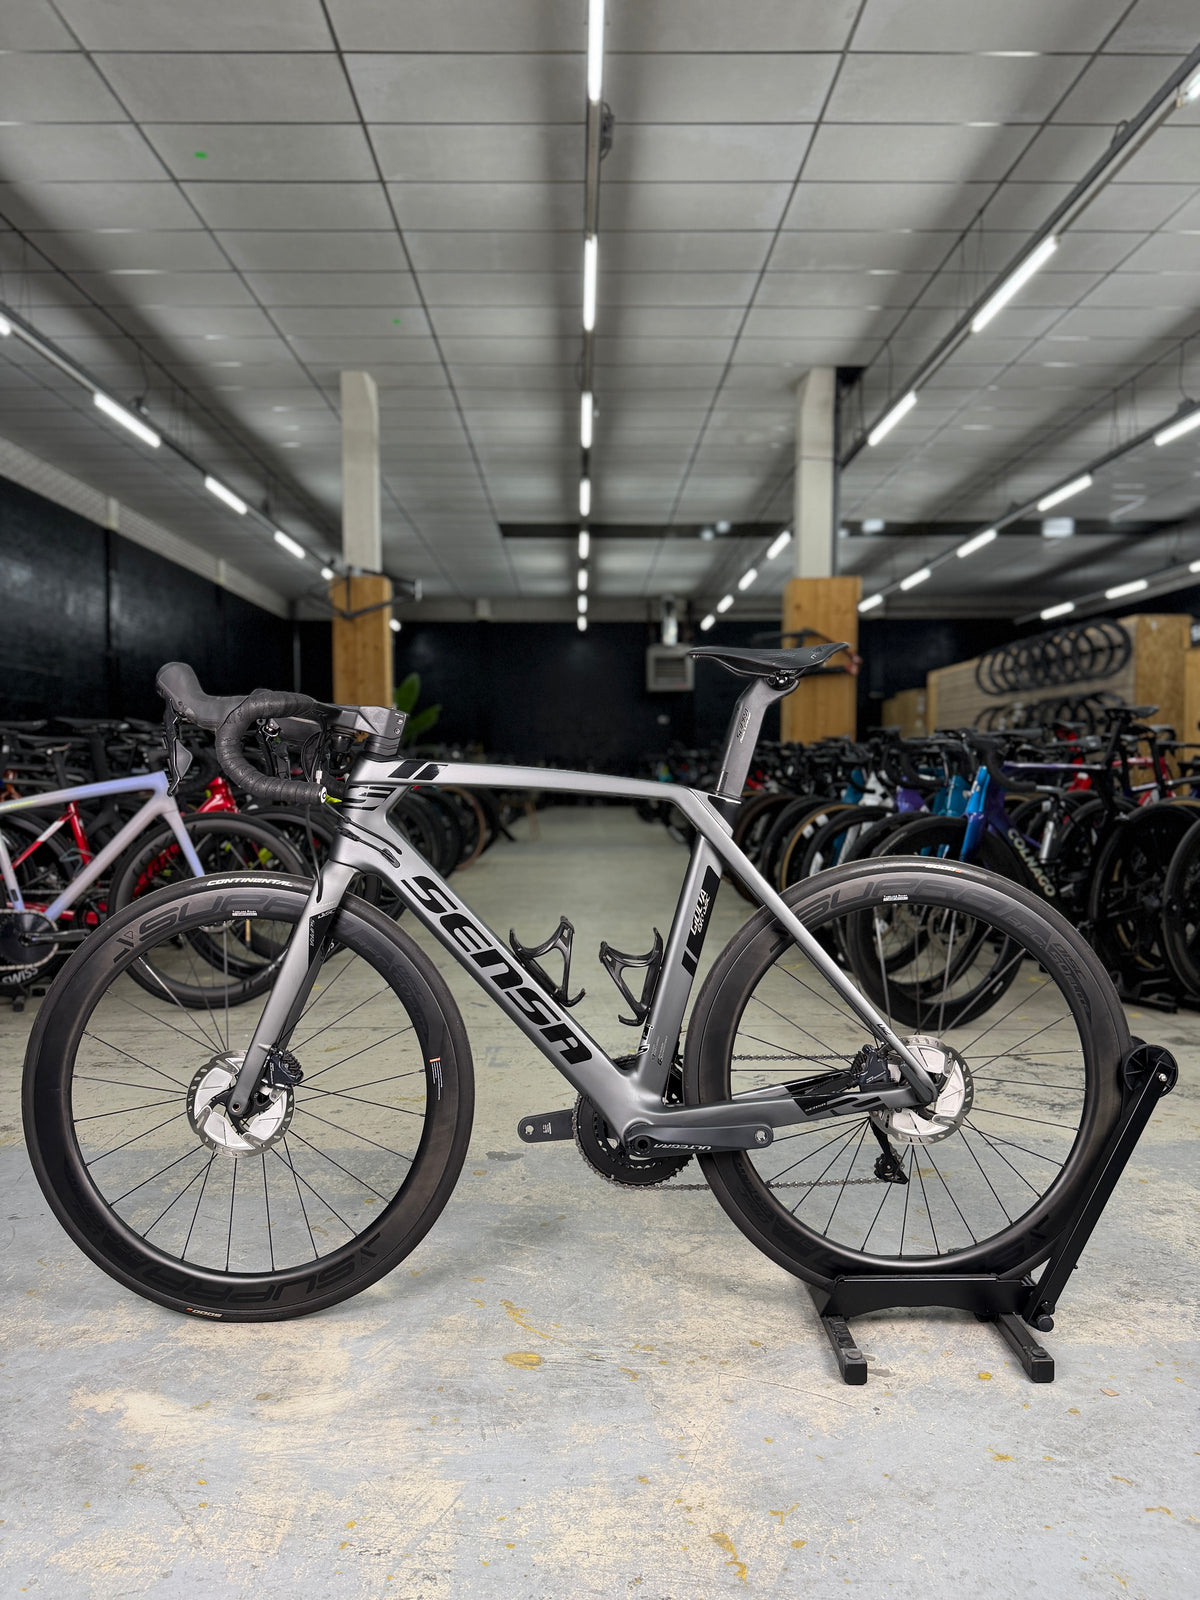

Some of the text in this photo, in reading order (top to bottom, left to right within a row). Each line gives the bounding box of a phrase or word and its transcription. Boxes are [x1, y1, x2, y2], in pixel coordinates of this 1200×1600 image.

[206, 876, 293, 887] CONTINENTAL
[1007, 827, 1056, 897] COLNAGO
[400, 875, 593, 1065] SENSA
[653, 1142, 712, 1151] ULTEGRA
